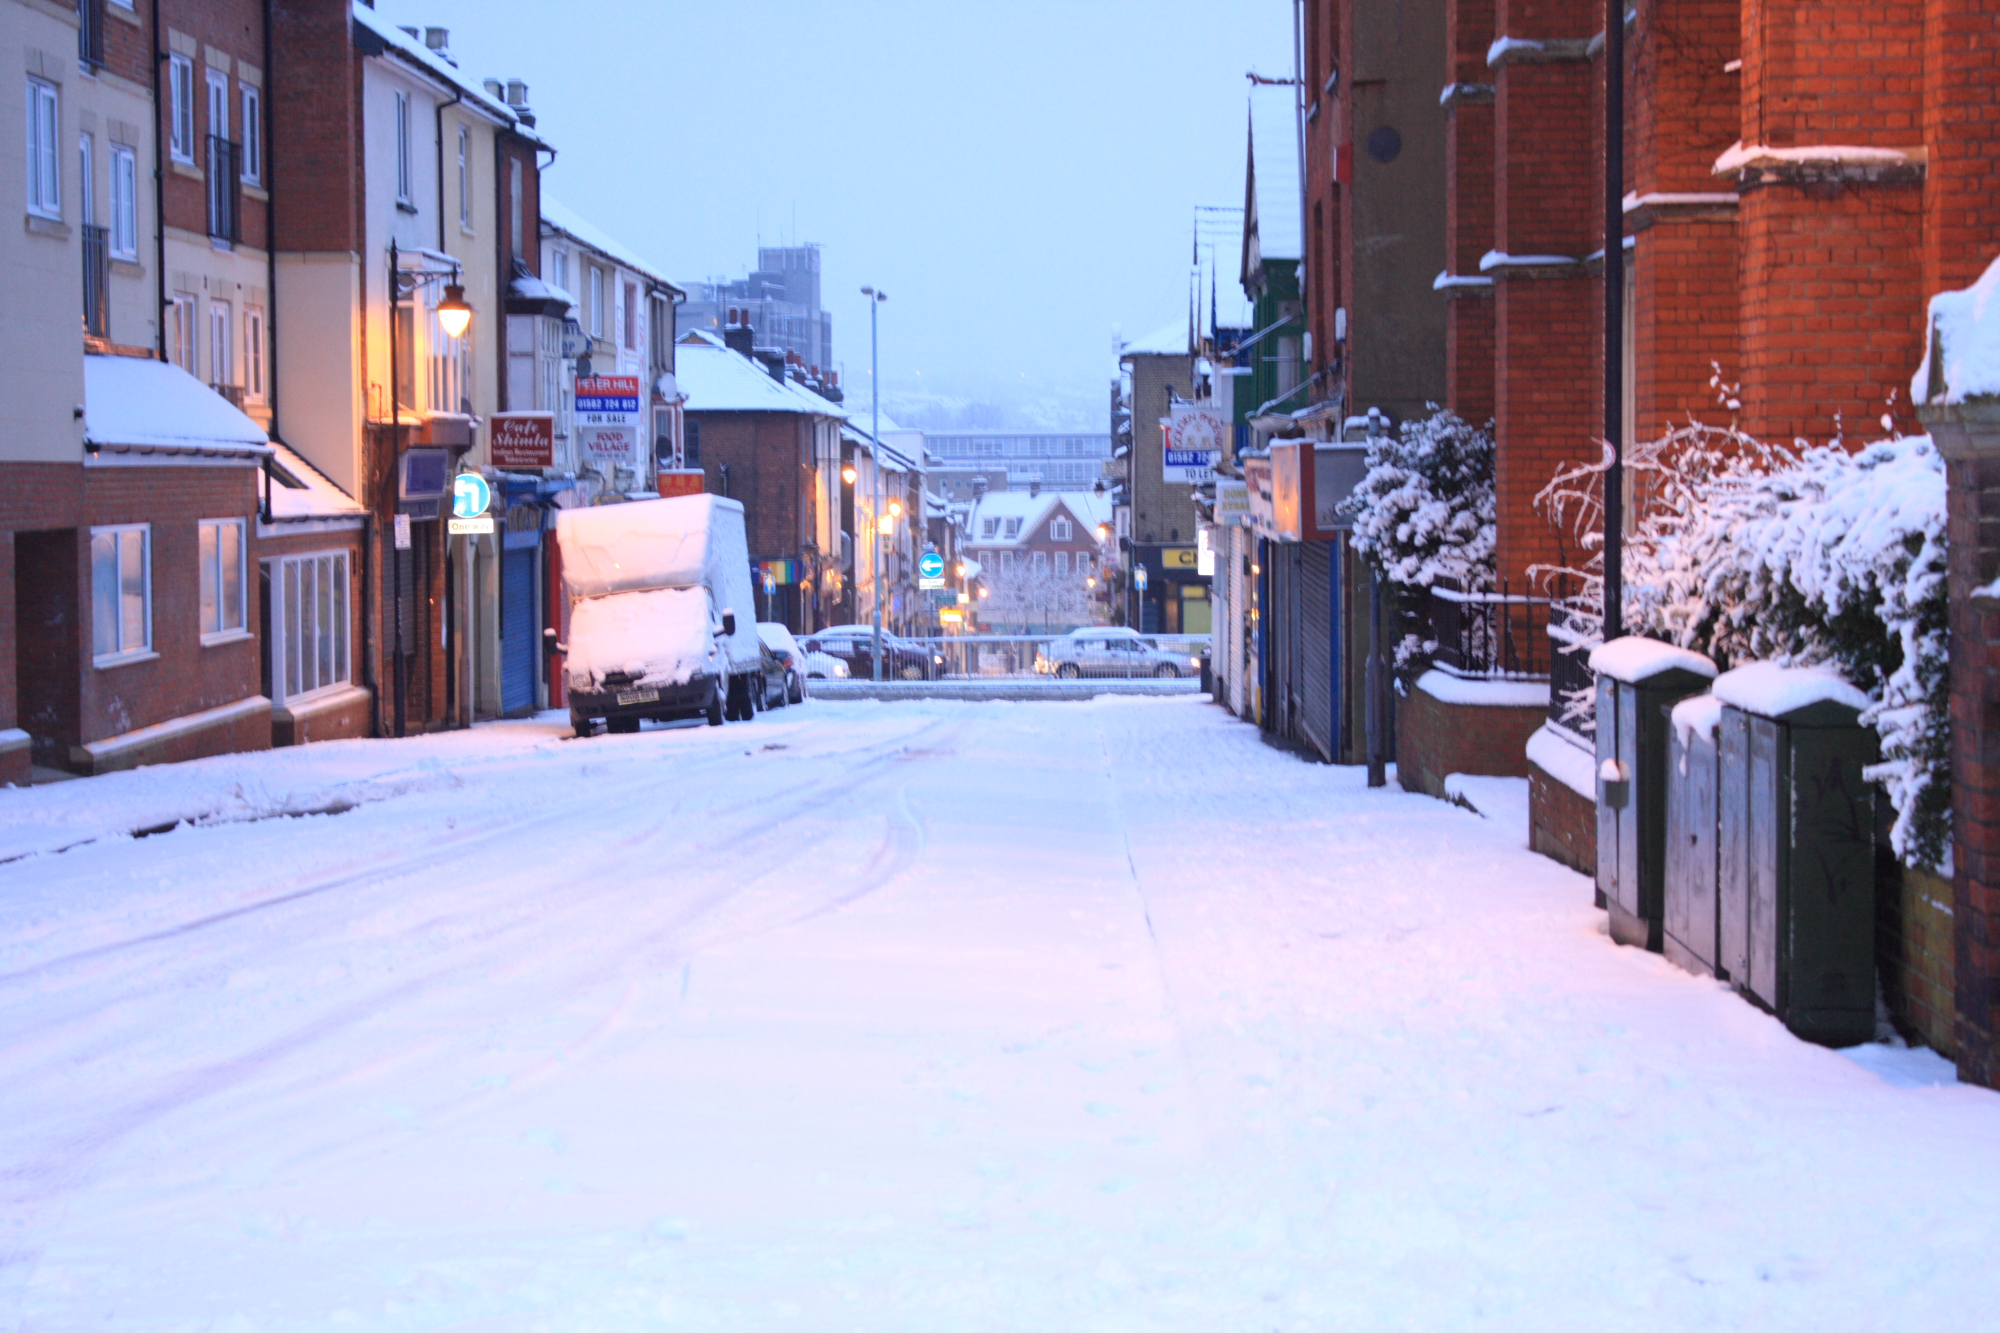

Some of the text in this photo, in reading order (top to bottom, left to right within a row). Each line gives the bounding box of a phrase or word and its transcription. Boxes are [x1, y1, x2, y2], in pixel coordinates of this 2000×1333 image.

[613, 379, 636, 390] HILL
[587, 413, 626, 423] FOR SALE
[503, 419, 539, 436] Cafe
[1174, 412, 1197, 449] GOLDEN
[493, 432, 549, 447] Shimla
[597, 432, 623, 441] FOOD
[588, 442, 630, 452] VILLAGE
[1185, 468, 1213, 479] TO LET
[451, 522, 470, 531] One
